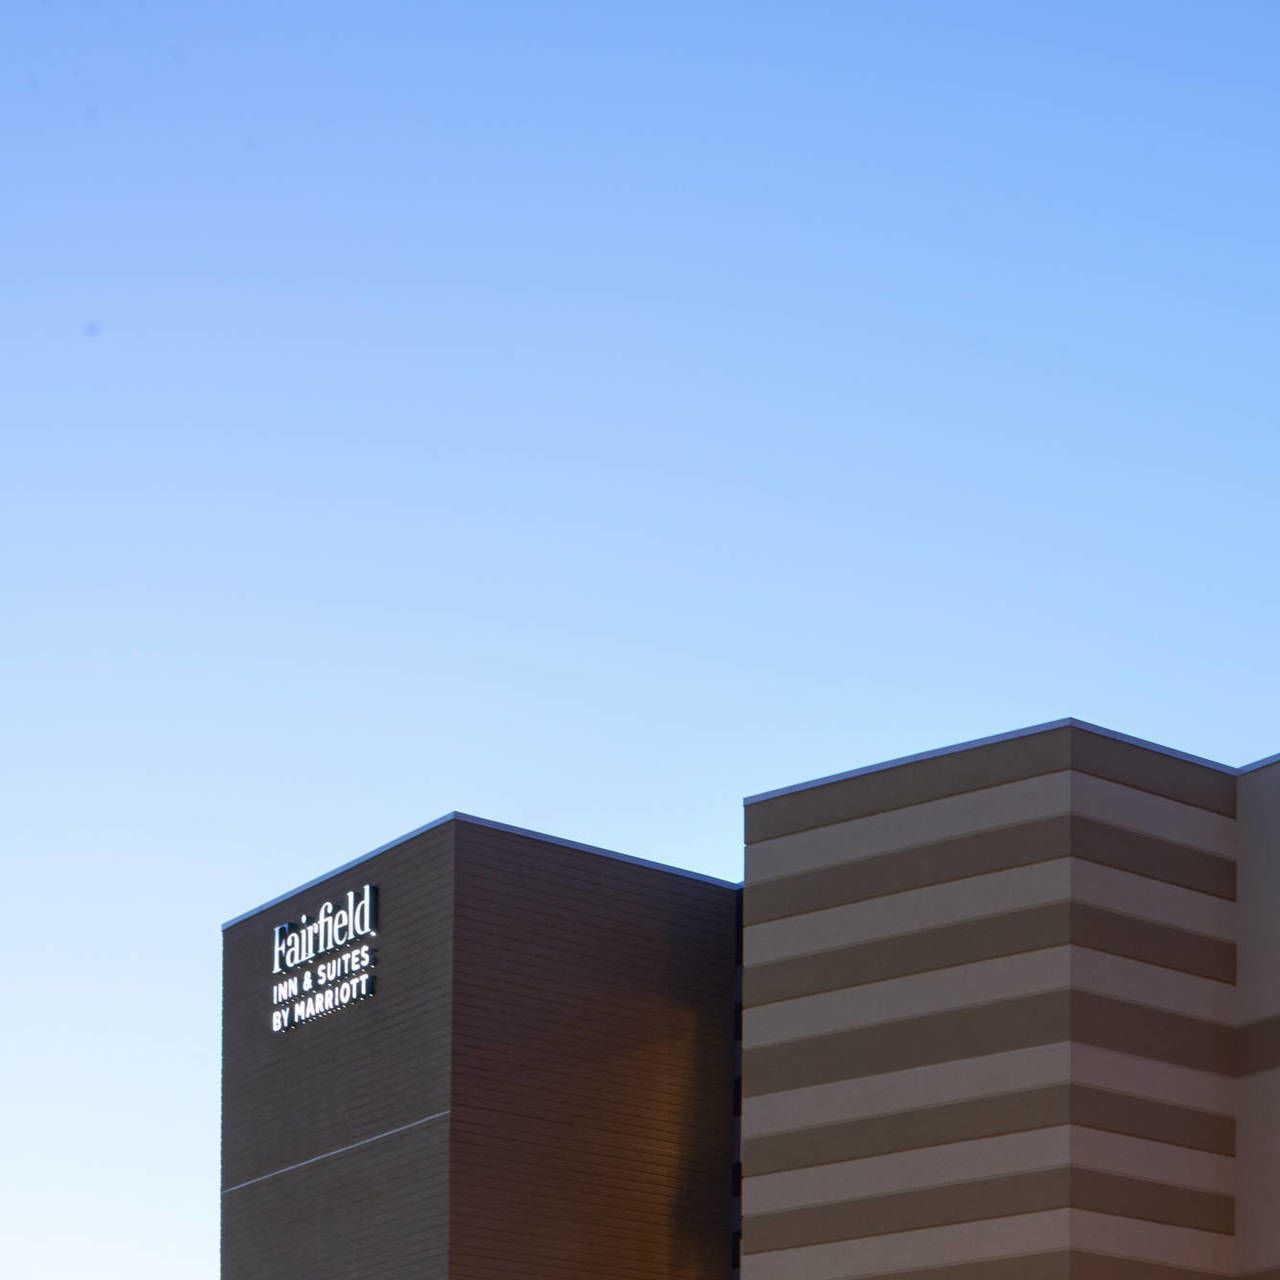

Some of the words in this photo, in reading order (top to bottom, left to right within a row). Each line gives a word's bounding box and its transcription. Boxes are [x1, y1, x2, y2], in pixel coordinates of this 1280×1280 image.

[272, 884, 372, 973] Fairfield
[272, 1008, 290, 1032] BY
[295, 974, 369, 1023] MARRIOTT
[273, 977, 298, 1004] INN
[303, 971, 312, 991] &
[317, 945, 369, 985] SUITES
